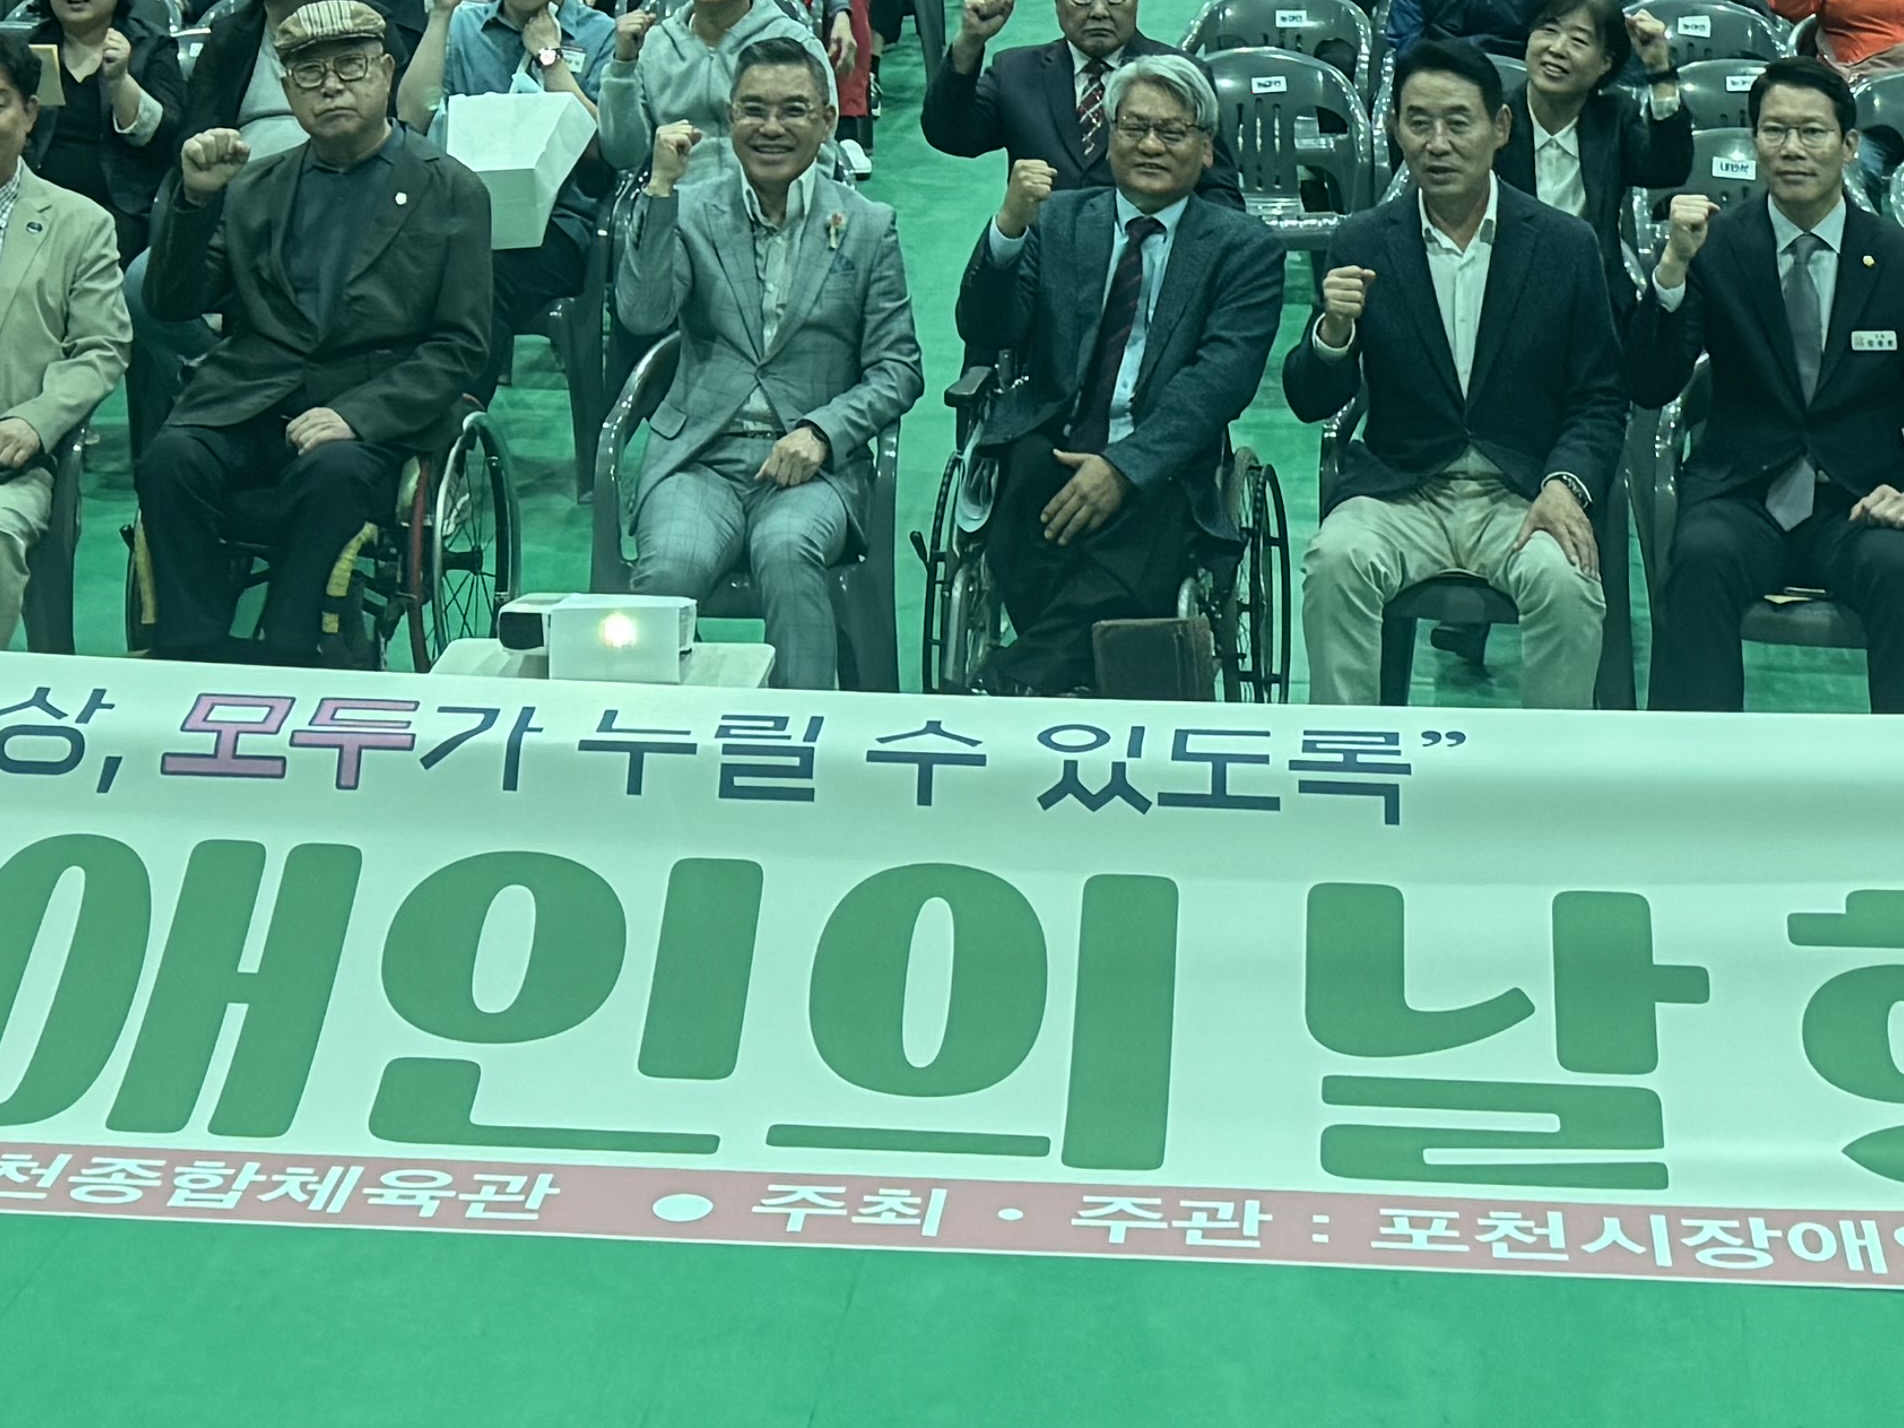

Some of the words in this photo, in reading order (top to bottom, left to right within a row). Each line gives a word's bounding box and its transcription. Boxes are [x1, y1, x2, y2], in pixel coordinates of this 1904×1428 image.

[159, 692, 544, 792] 모두가
[577, 709, 825, 803] 누릴
[865, 720, 987, 807] 수
[1036, 724, 1467, 826] 있도록”
[1304, 882, 1711, 1191] 날
[750, 1183, 949, 1239] 주최
[1070, 1192, 1275, 1249] 주관
